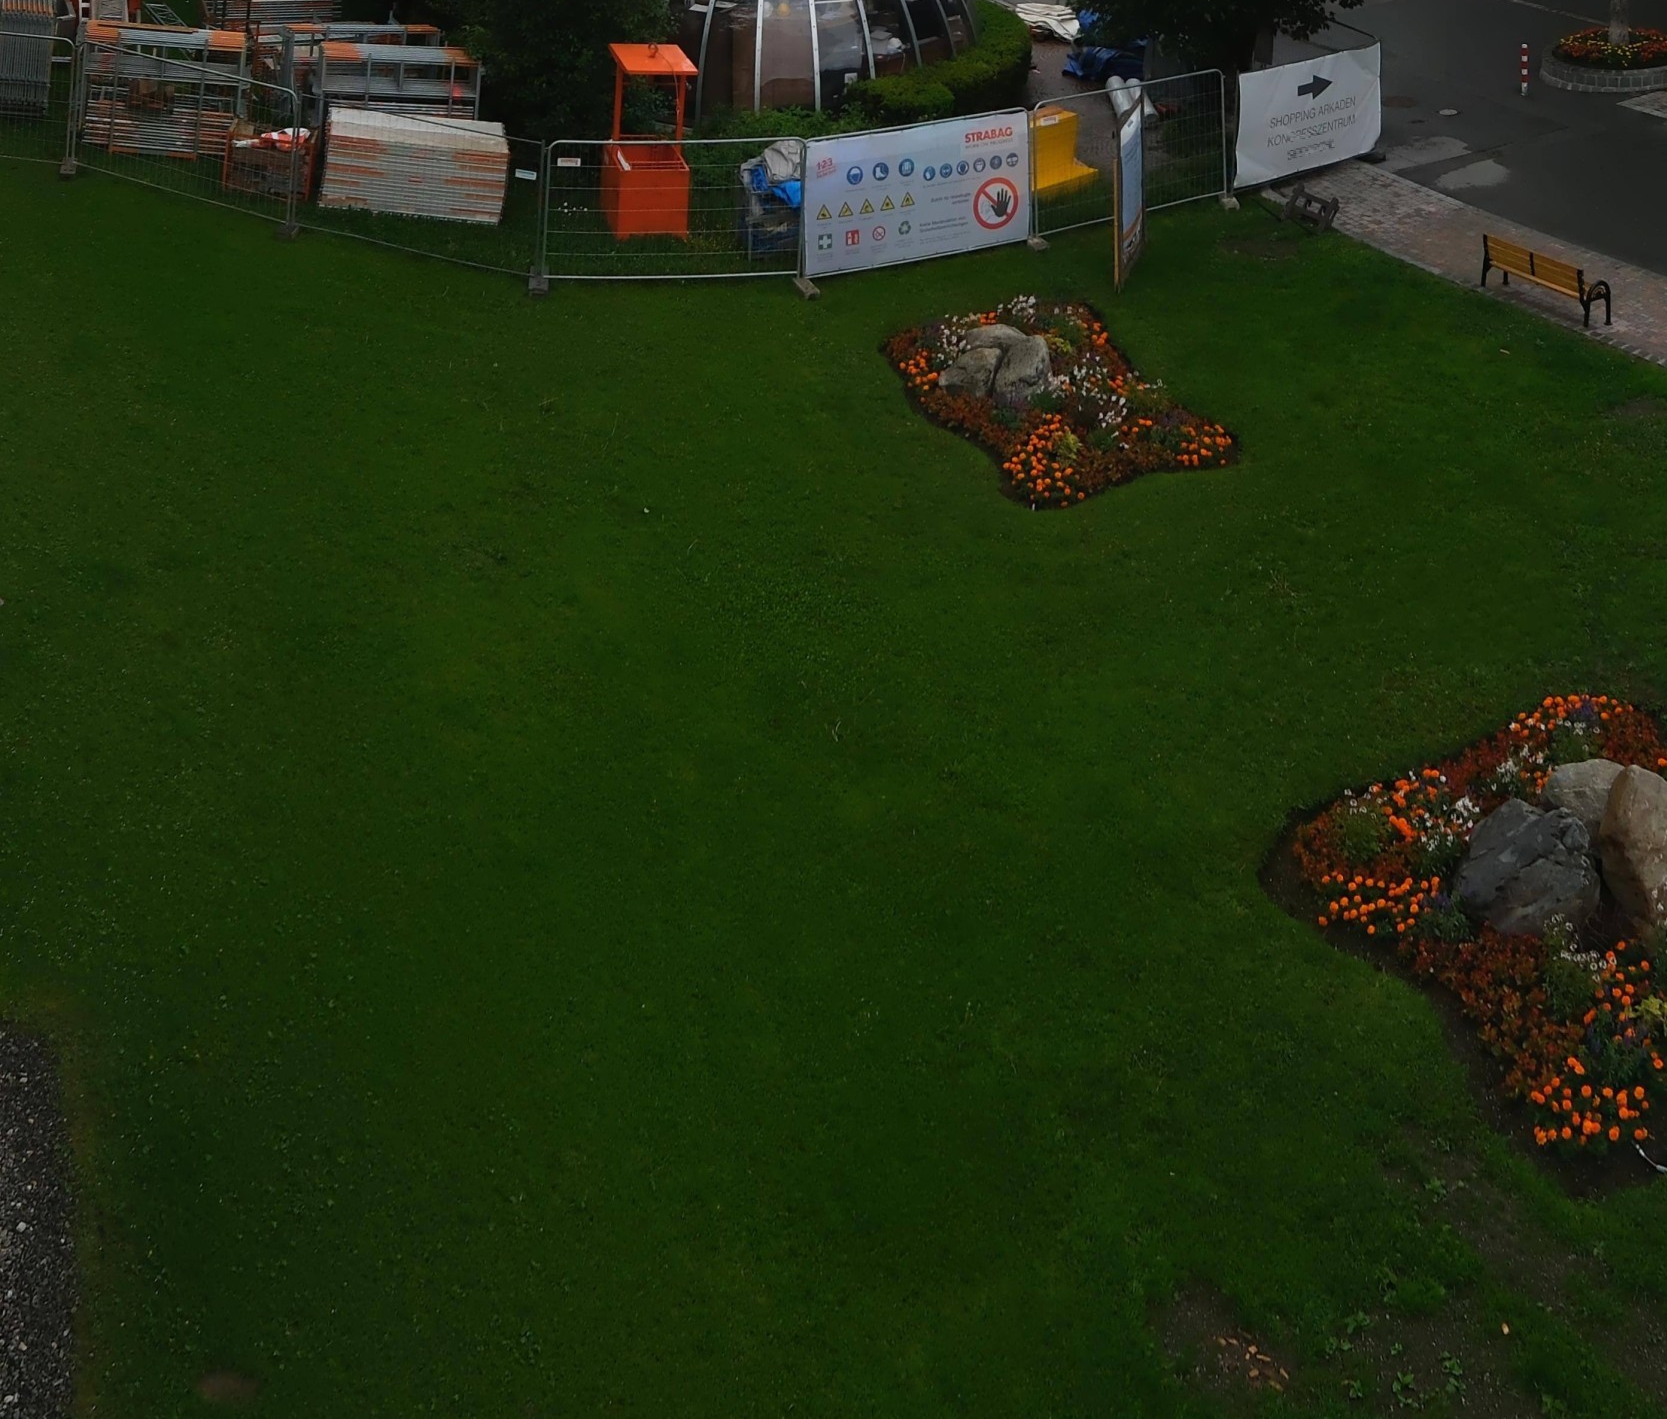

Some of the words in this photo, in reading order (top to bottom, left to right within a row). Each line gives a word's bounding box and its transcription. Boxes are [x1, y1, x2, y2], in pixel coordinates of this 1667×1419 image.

[1269, 108, 1316, 129] SHOPPING
[1318, 96, 1357, 117] ARKADEN
[964, 126, 1013, 144] STRABAG
